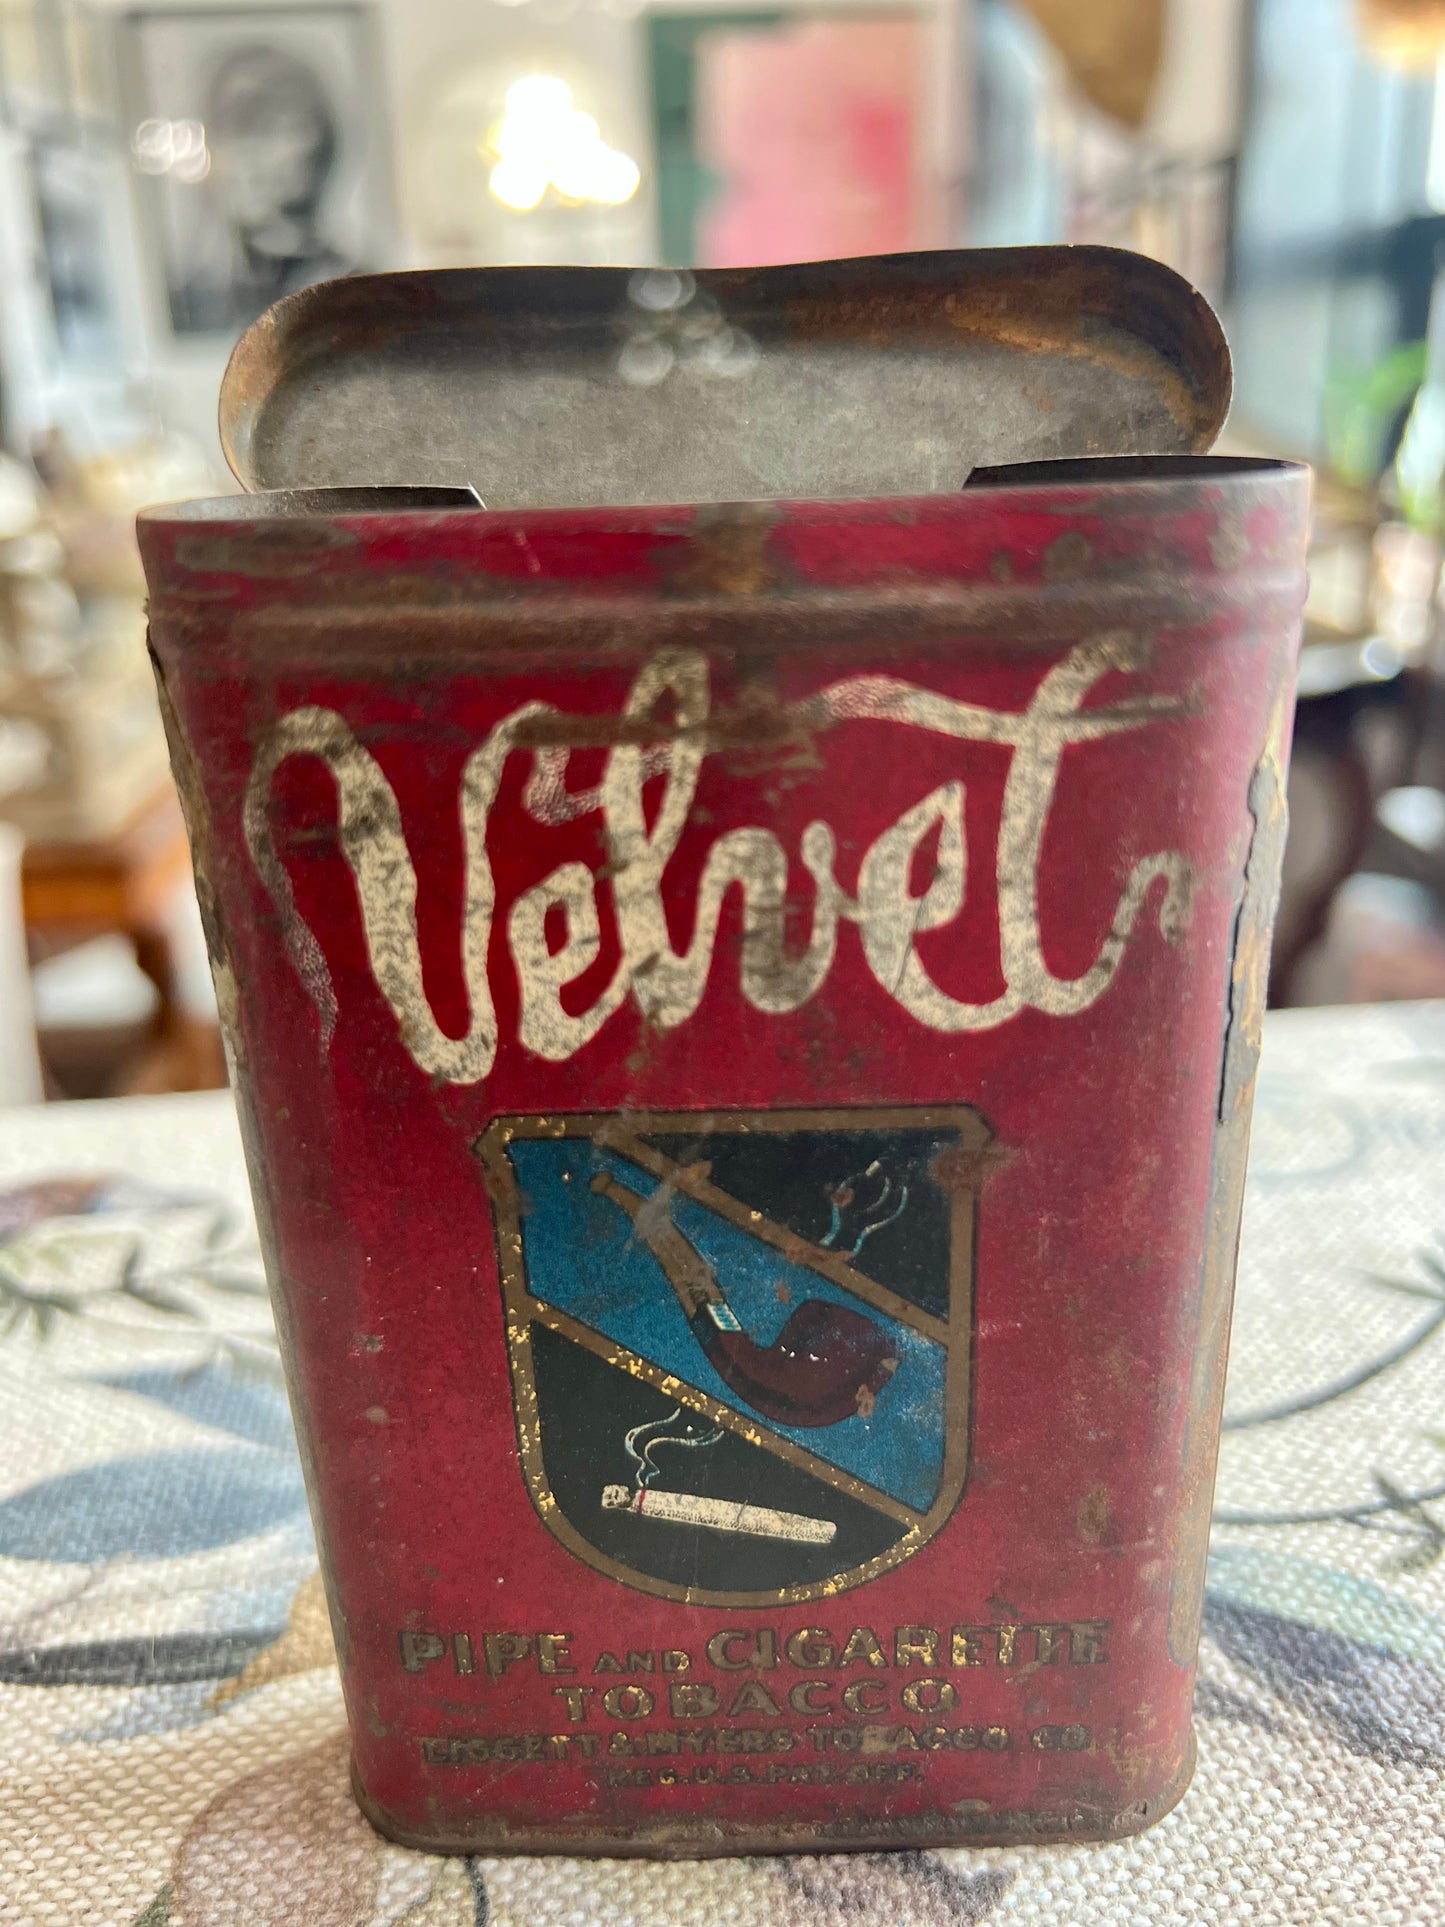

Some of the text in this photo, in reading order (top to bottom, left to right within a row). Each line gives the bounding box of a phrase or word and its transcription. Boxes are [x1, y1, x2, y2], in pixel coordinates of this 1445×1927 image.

[243, 628, 1210, 1085] Velvet
[397, 1620, 1113, 1676] PIPE AND CIGARETTE
[552, 1677, 960, 1723] TOBACCO
[420, 1732, 602, 1763] LIGGETT
[644, 1726, 796, 1757] MYERS
[805, 1723, 1011, 1754] TOACCO
